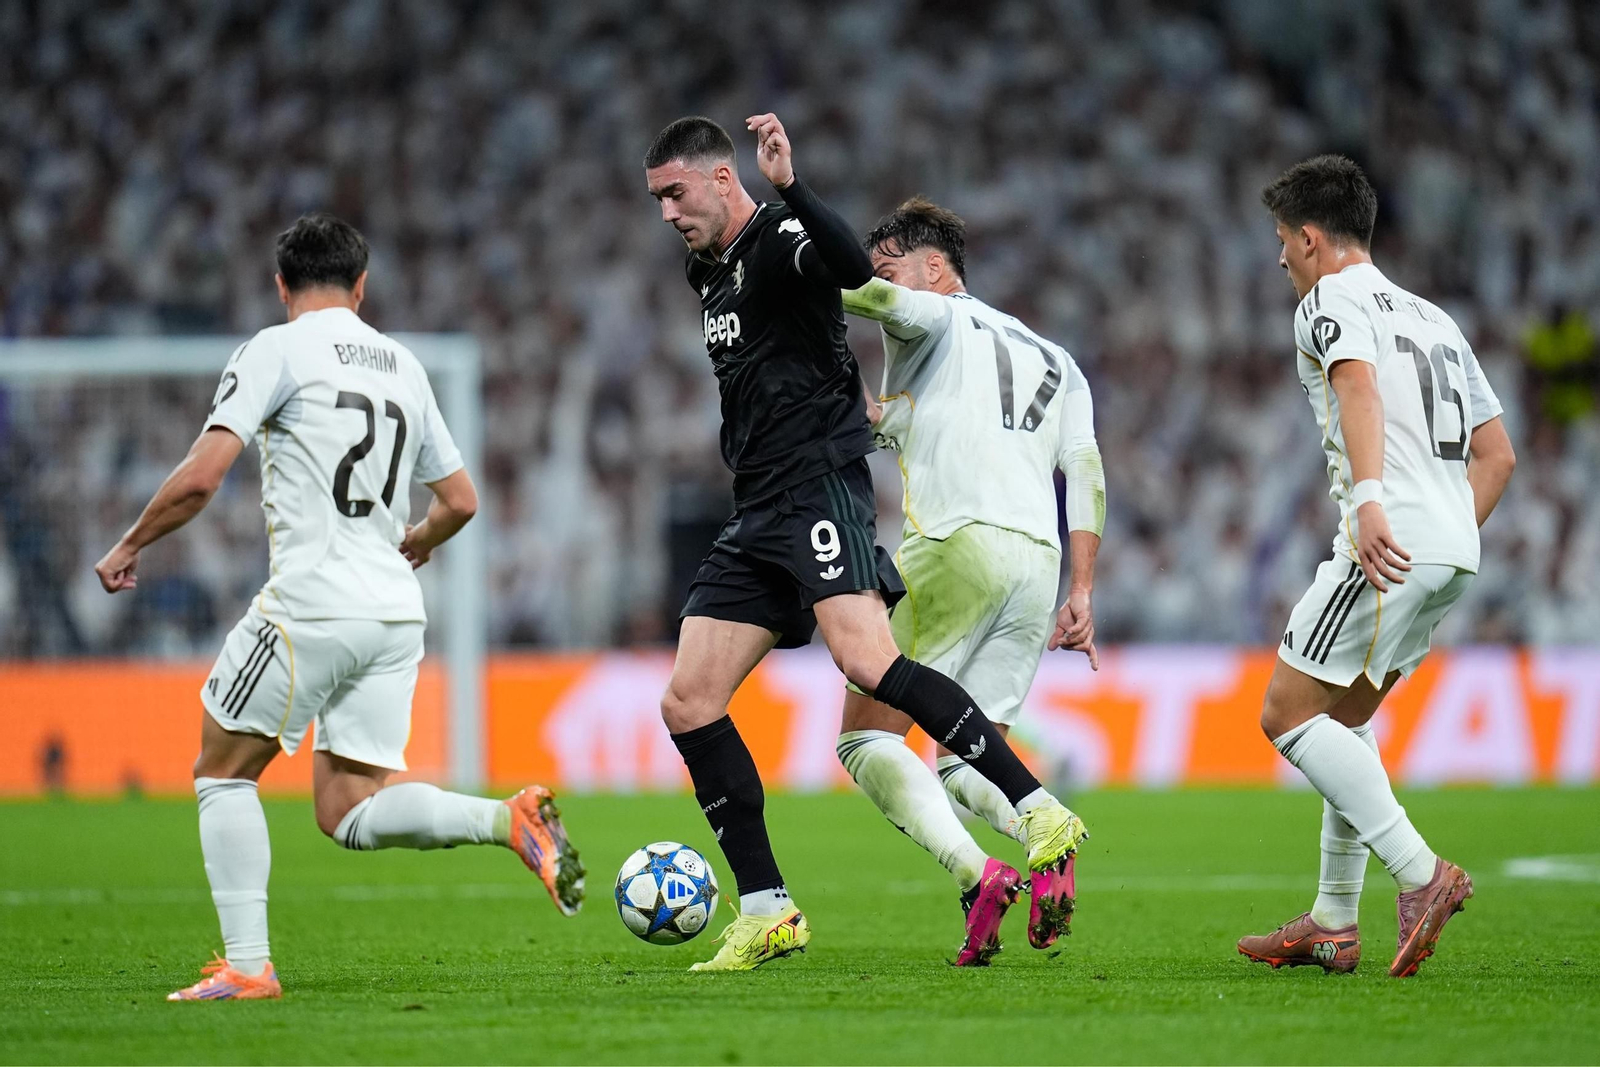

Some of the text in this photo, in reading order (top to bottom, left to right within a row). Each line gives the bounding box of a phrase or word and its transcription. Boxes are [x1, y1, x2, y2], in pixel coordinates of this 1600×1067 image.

[704, 309, 741, 347] Jeep
[333, 344, 398, 374] BRAHIM
[810, 520, 841, 563] 9
